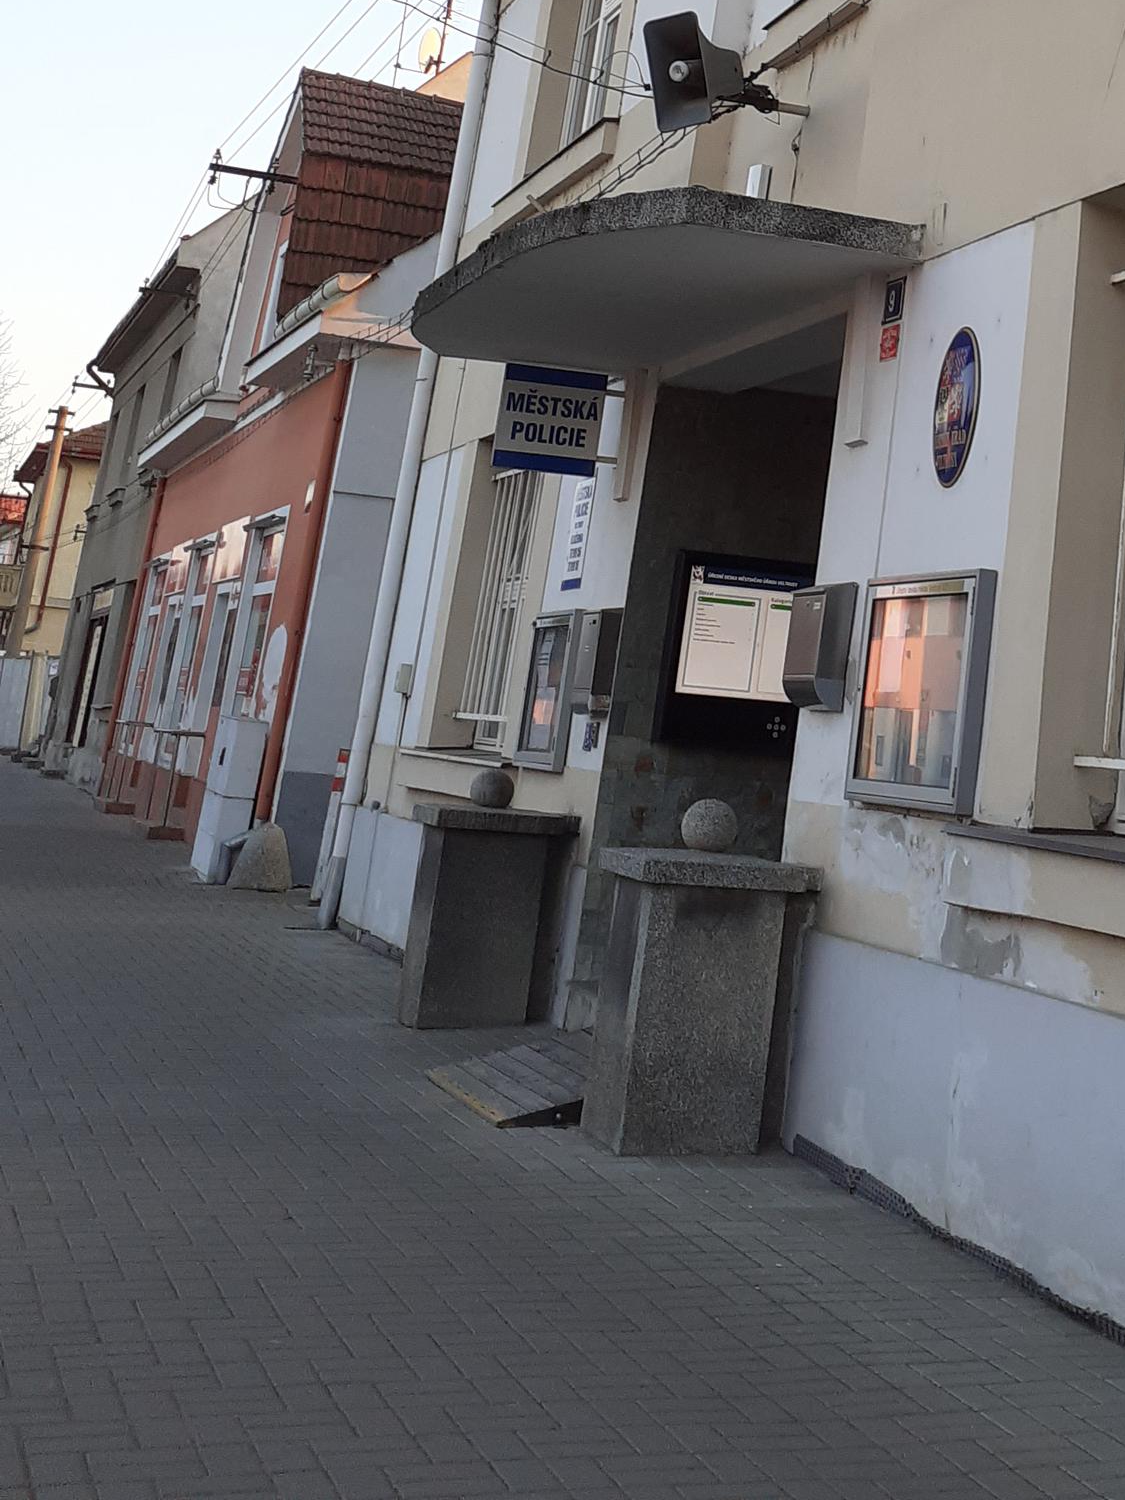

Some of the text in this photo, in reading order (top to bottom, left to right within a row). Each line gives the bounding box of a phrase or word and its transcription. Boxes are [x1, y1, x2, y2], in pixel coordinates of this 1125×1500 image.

[888, 290, 896, 313] 9
[505, 388, 598, 421] MĚSTSKÁ
[510, 420, 587, 448] POLICIE
